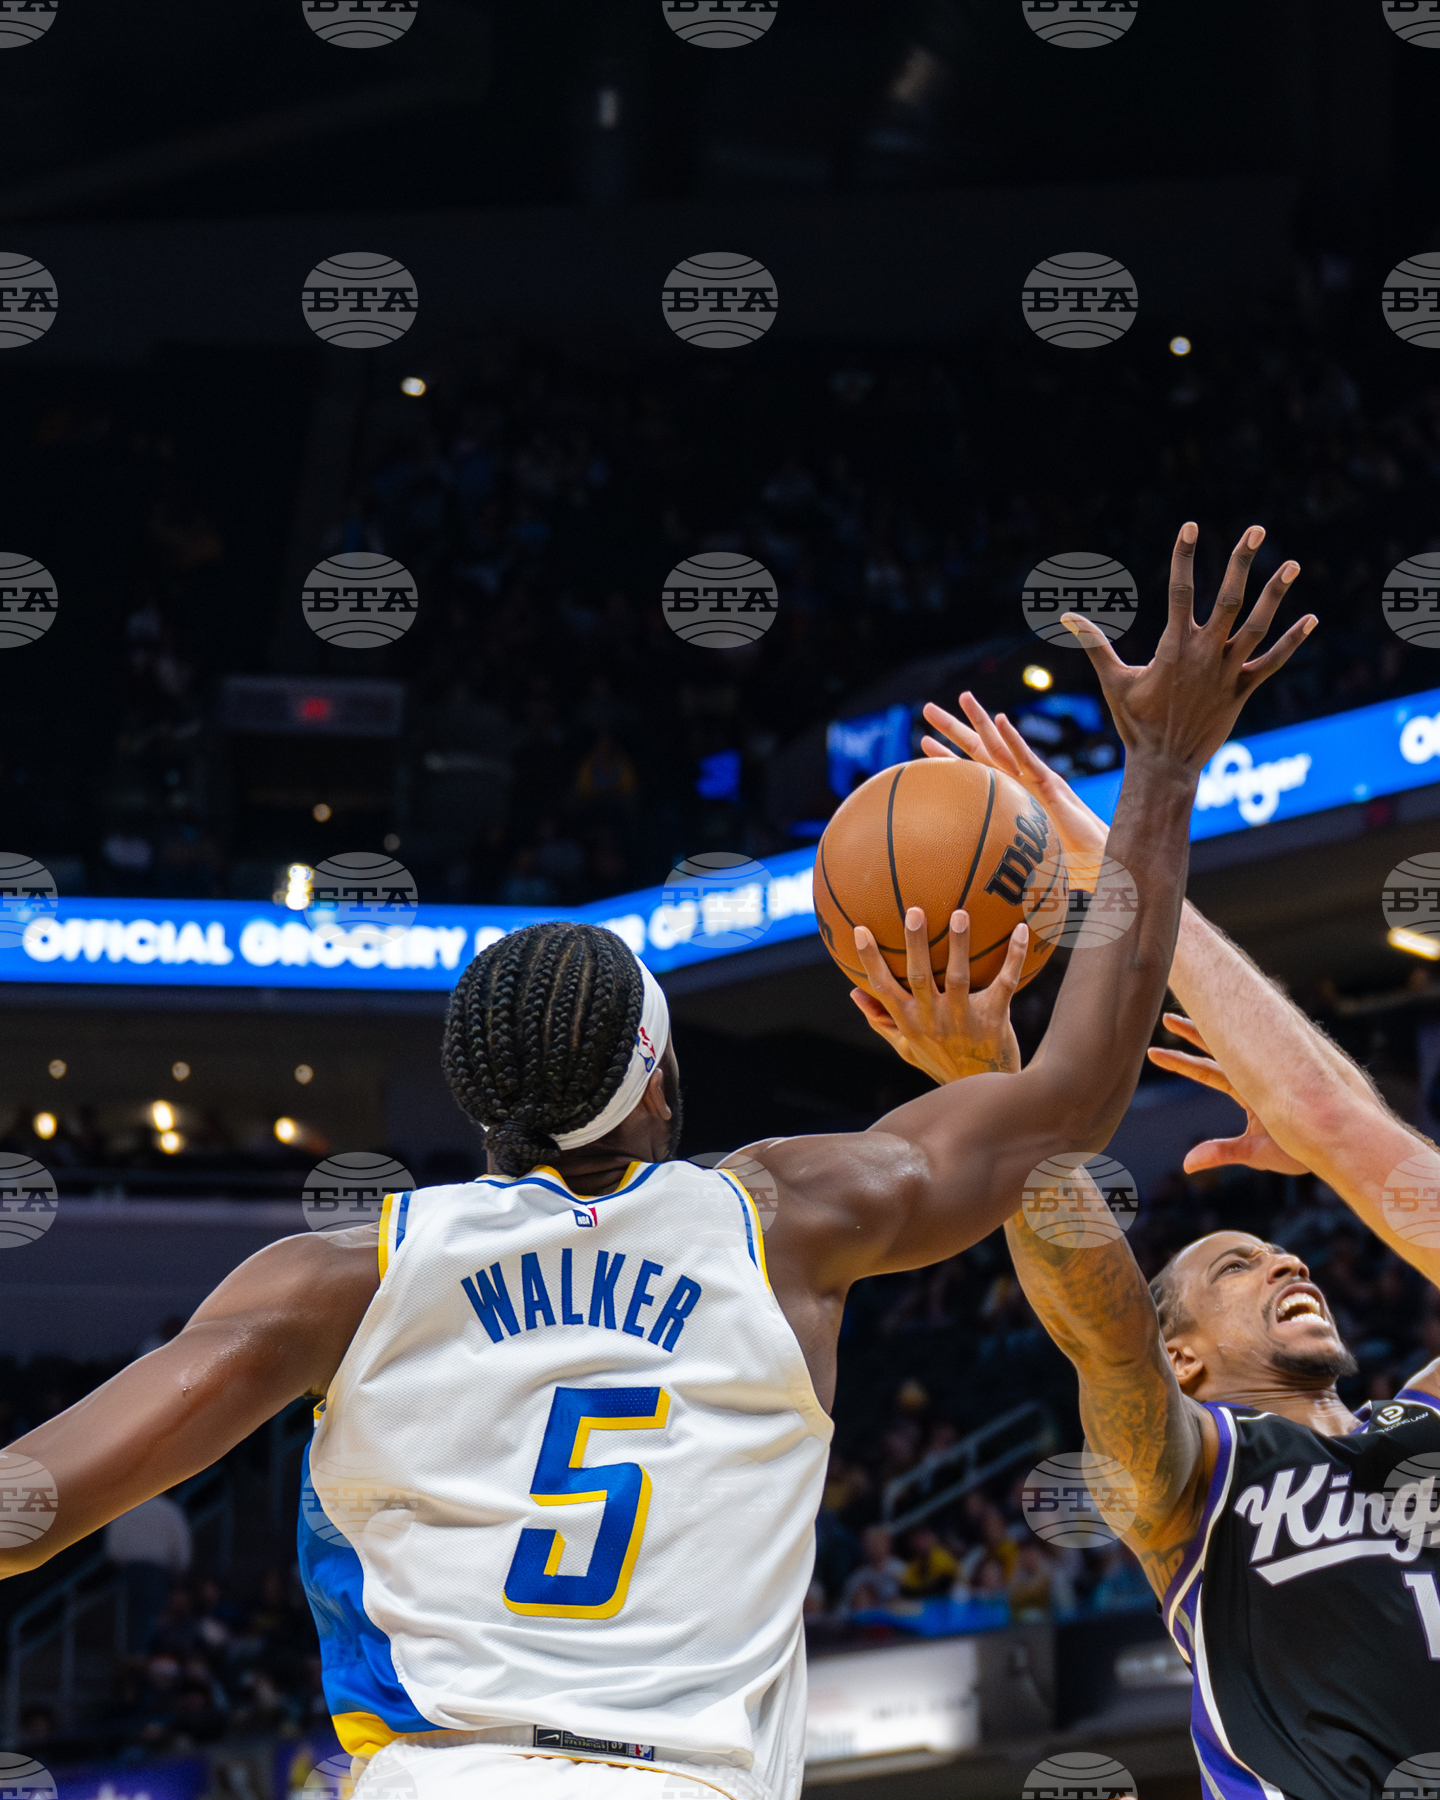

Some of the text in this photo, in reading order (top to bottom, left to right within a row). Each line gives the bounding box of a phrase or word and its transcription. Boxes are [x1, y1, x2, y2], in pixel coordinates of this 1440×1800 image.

[22, 916, 233, 965] OFFICIAL
[239, 918, 467, 970] GROCERY
[461, 1247, 703, 1354] WALKER
[502, 1386, 672, 1620] 5
